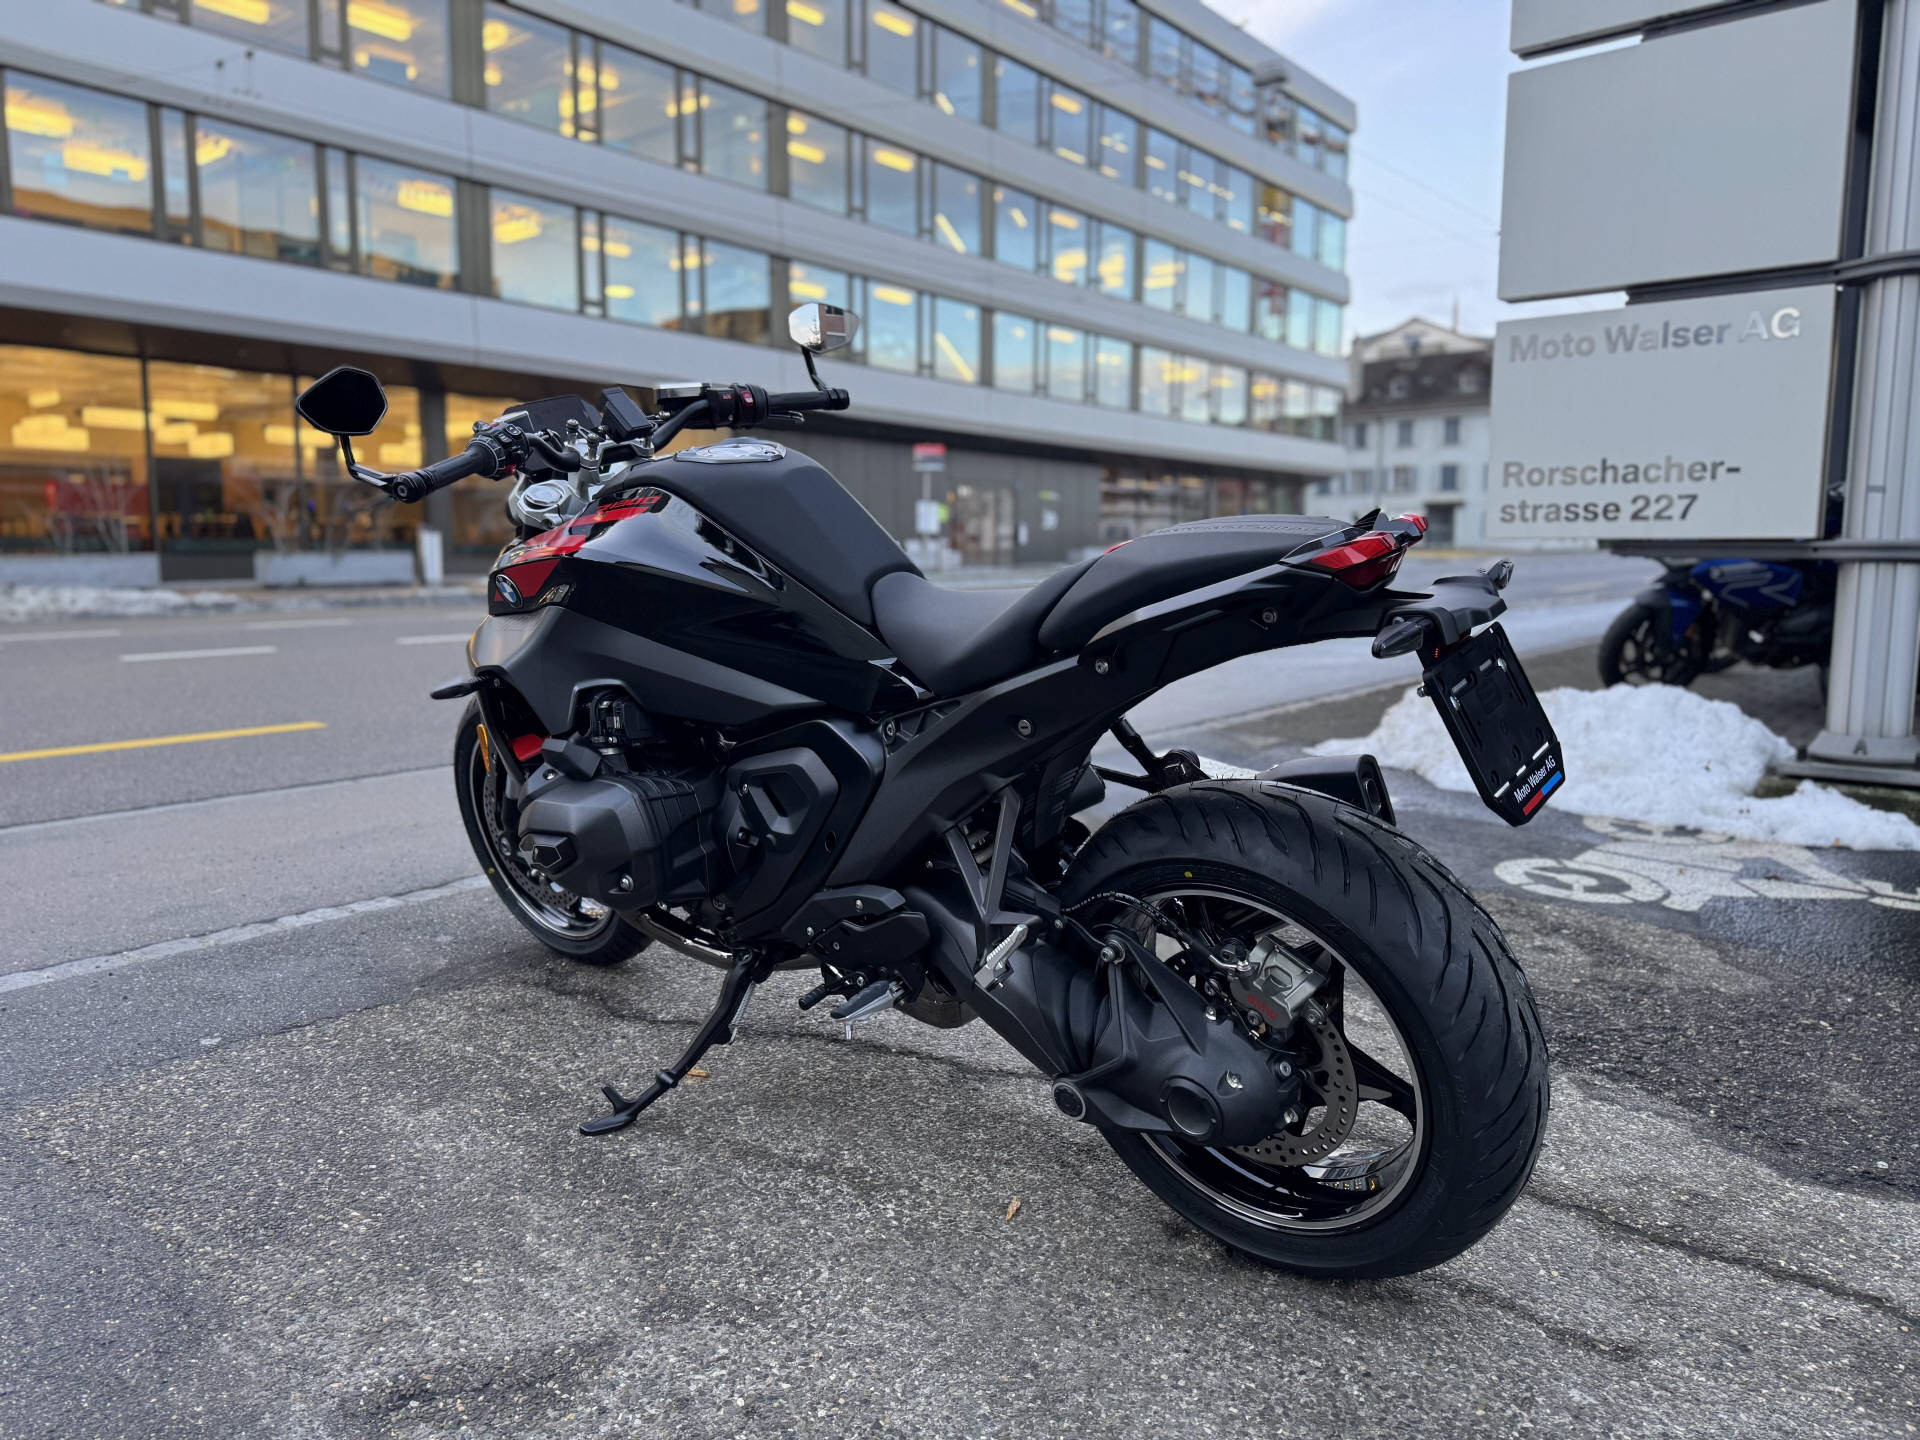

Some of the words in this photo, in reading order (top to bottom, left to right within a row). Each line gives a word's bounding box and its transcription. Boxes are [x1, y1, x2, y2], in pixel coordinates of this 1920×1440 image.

[1509, 332, 1596, 363] Moto
[1603, 320, 1732, 354] Walser
[1738, 307, 1801, 343] AG
[1502, 456, 1741, 488] Rorschacher-
[1499, 499, 1621, 524] strasse
[1630, 494, 1698, 522] 227
[1513, 784, 1531, 803] Moto
[1527, 765, 1548, 788] Walser
[1545, 755, 1556, 771] AG
